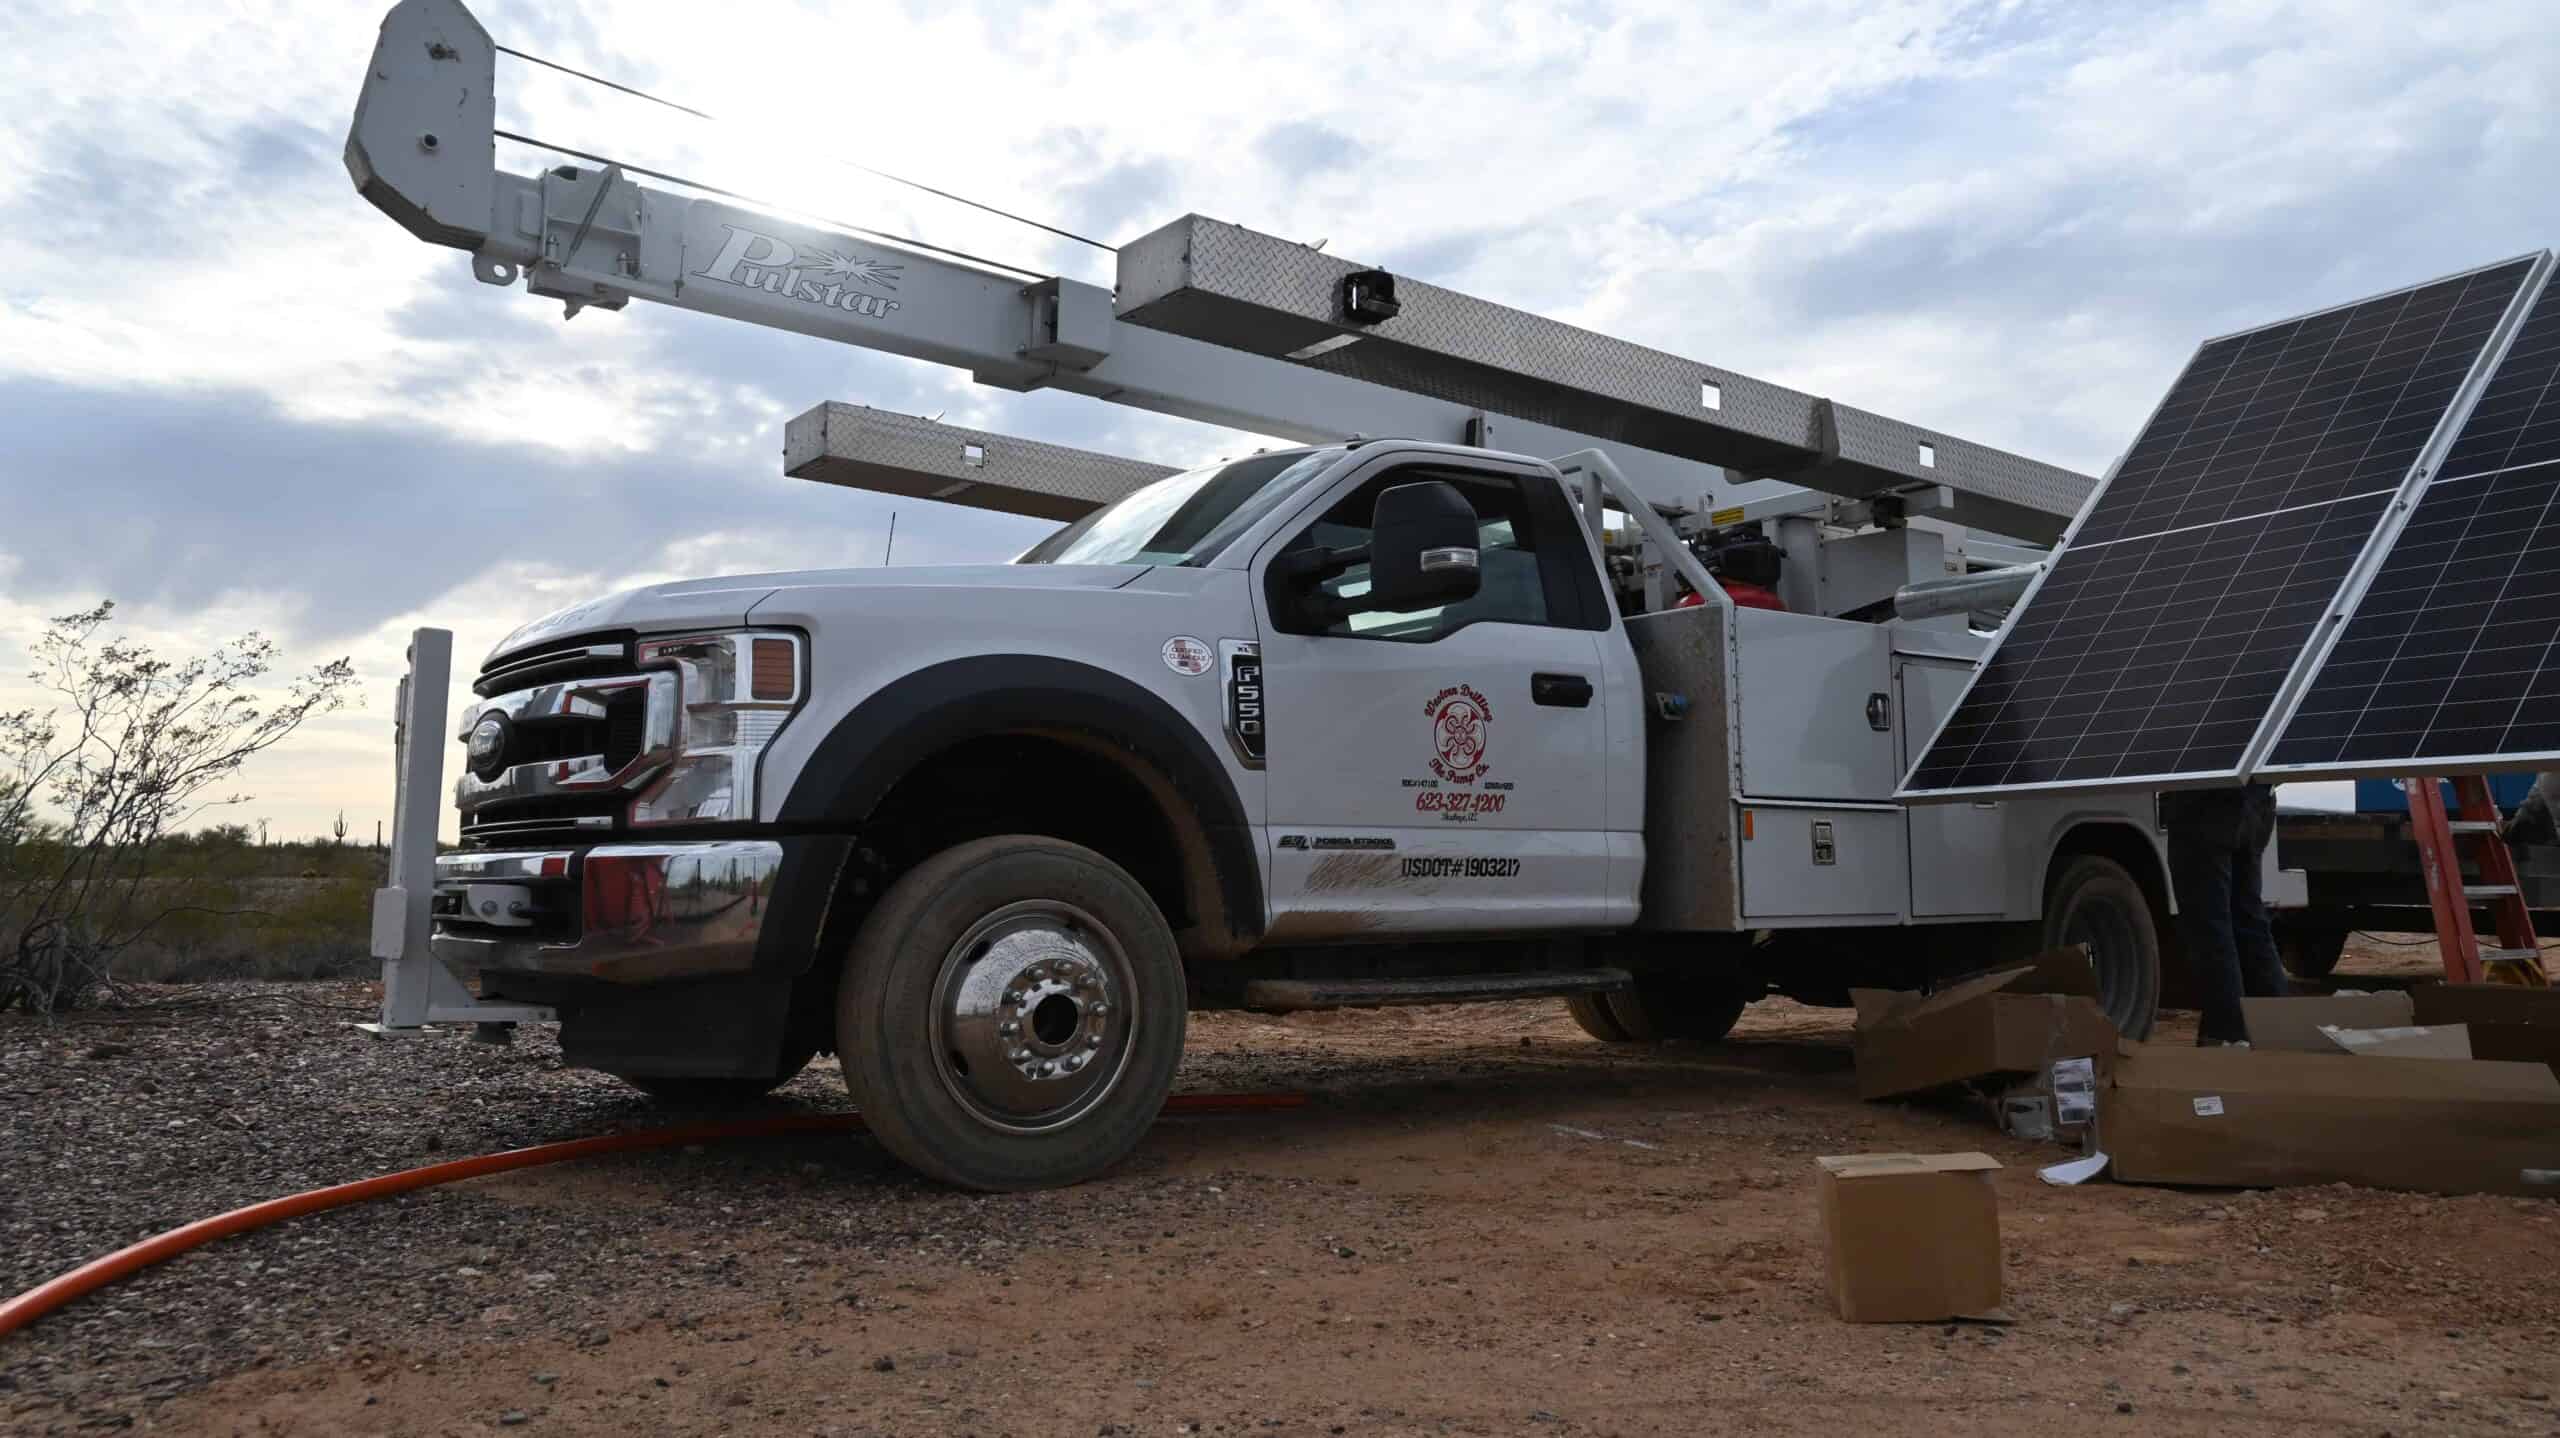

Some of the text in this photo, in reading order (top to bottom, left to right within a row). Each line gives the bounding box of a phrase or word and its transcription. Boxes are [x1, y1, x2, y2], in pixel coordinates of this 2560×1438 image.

[691, 224, 900, 319] Pulstar
[1237, 665, 1261, 734] F550
[1424, 684, 1493, 722] Western Drilling
[1429, 758, 1446, 779] The
[1446, 769, 1475, 786] Pump
[1416, 792, 1505, 812] 623-327-1200
[1401, 857, 1521, 878] USDOT#1903217
